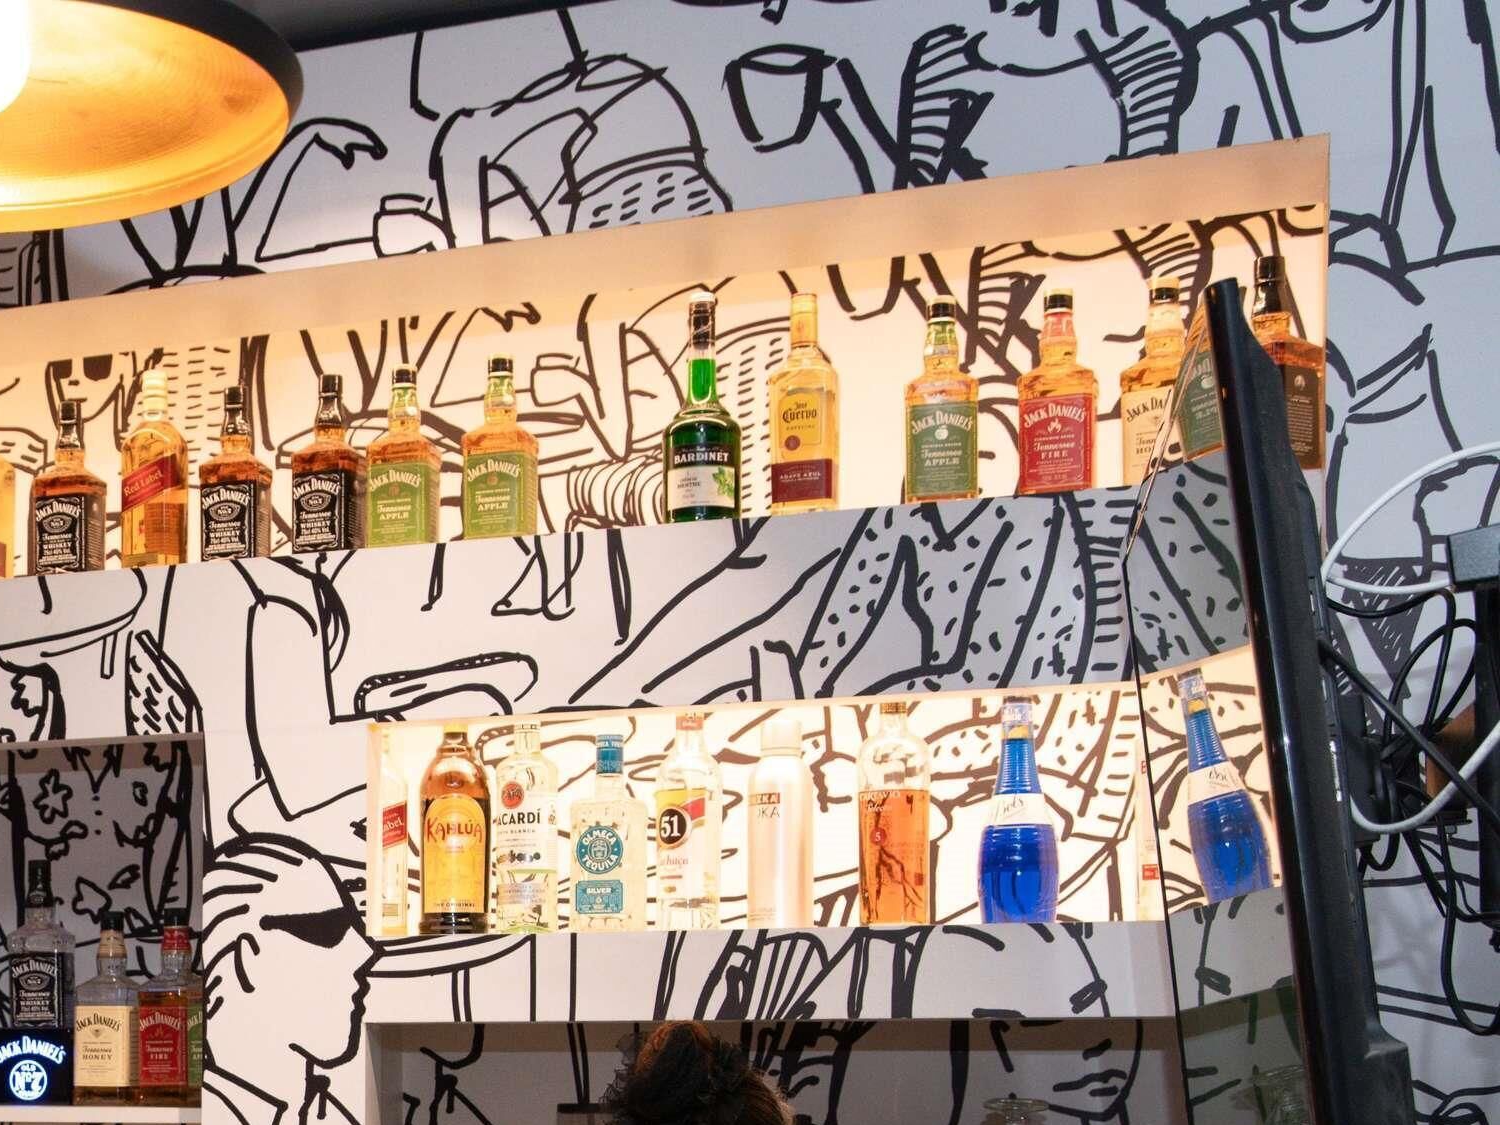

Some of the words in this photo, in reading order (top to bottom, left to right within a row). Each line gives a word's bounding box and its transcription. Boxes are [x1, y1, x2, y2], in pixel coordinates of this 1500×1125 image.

[782, 408, 817, 424] Cuervo
[911, 415, 936, 435] JACK
[936, 410, 973, 432] DANIEL'S
[1023, 406, 1048, 428] JACK
[1048, 402, 1087, 423] DANIEL'S
[1126, 401, 1149, 424] JACK
[674, 451, 729, 465] BARDINET
[370, 473, 389, 491] JACK
[389, 469, 421, 488] DANIEL'S
[467, 464, 487, 482] JACK
[487, 458, 521, 478] DANIEL'S
[124, 482, 140, 497] Red
[202, 491, 220, 510] JACK
[220, 488, 251, 506] DANIEL'S
[293, 481, 311, 500] JACK
[311, 478, 341, 495] DANIEL'S
[35, 505, 52, 521] JACK
[52, 501, 81, 519] DANIEL'S
[497, 808, 541, 826] ACARDÍ
[660, 815, 681, 838] 51
[426, 818, 483, 843] KAHLÚA
[582, 829, 617, 846] OLMECA
[11, 963, 30, 977] JACK
[76, 1016, 93, 1032] JACK
[93, 1012, 122, 1032] DANIEL'S
[139, 1015, 155, 1032] JACK
[22, 1035, 67, 1065] DANIEL'S
